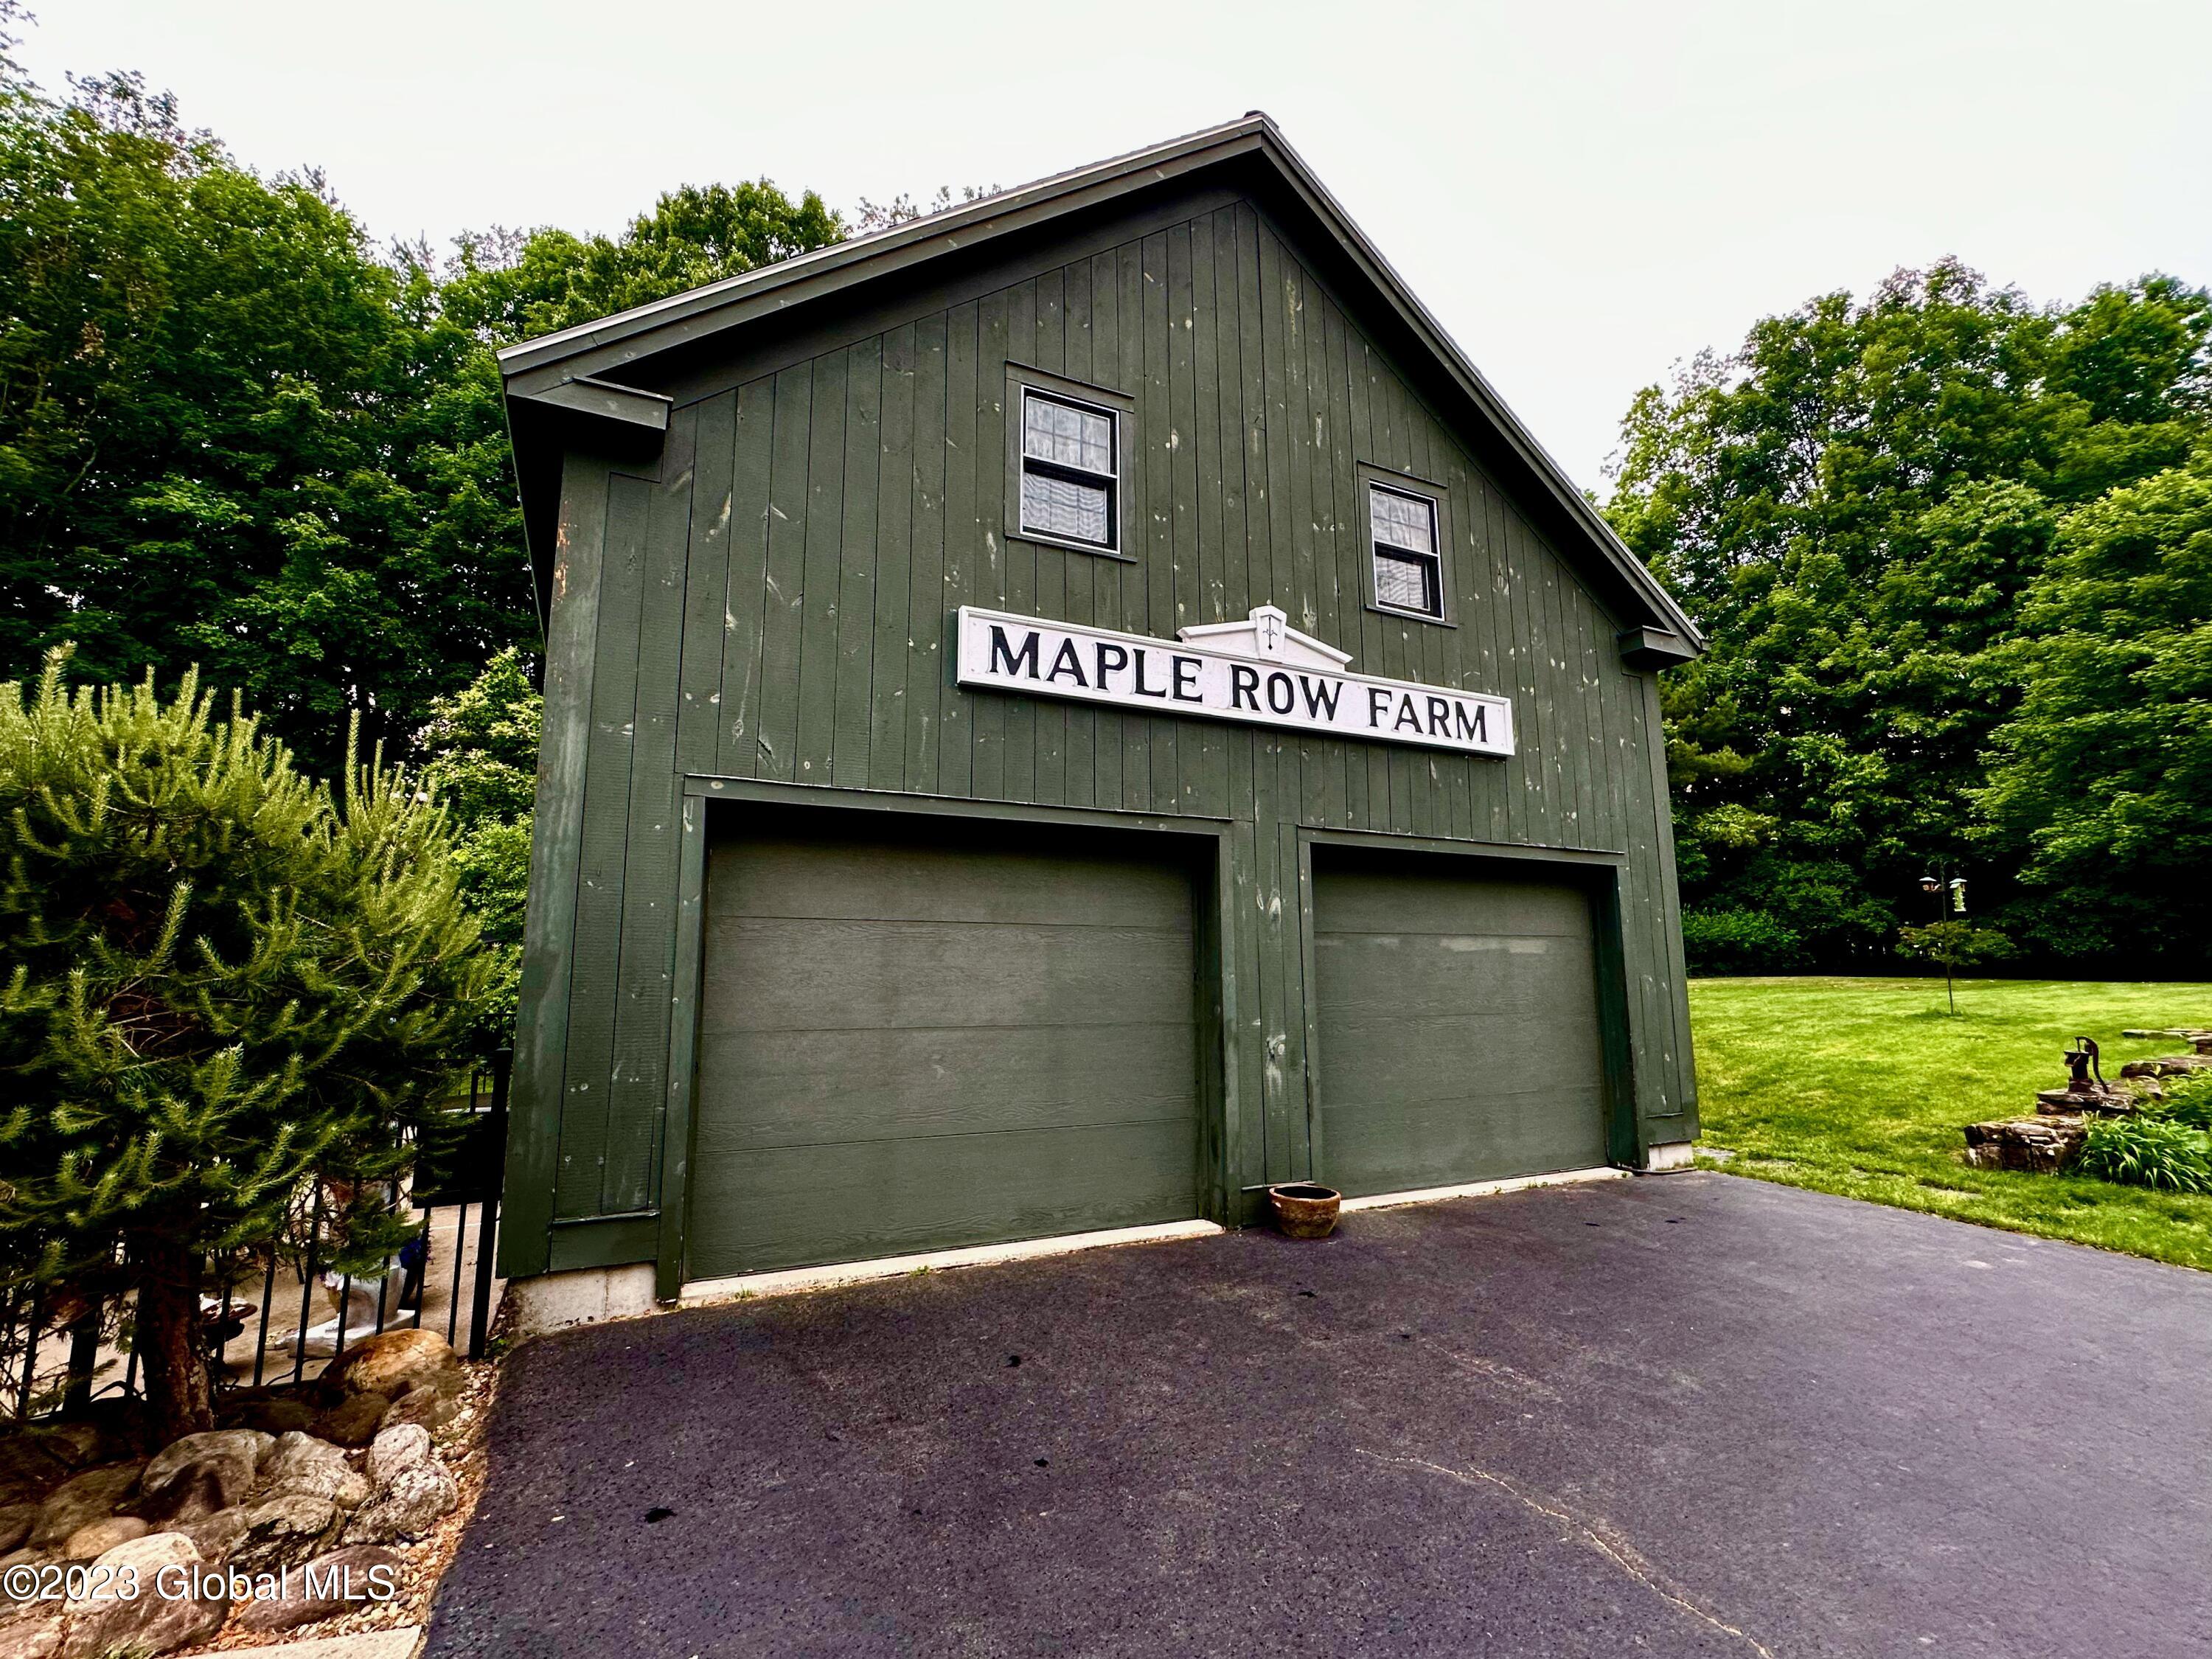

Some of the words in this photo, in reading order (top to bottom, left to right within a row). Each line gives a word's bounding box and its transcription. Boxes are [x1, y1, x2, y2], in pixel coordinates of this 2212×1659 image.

[989, 625, 1204, 703] MAPLE
[1229, 664, 1343, 721] ROW
[1367, 687, 1488, 744] FARM
